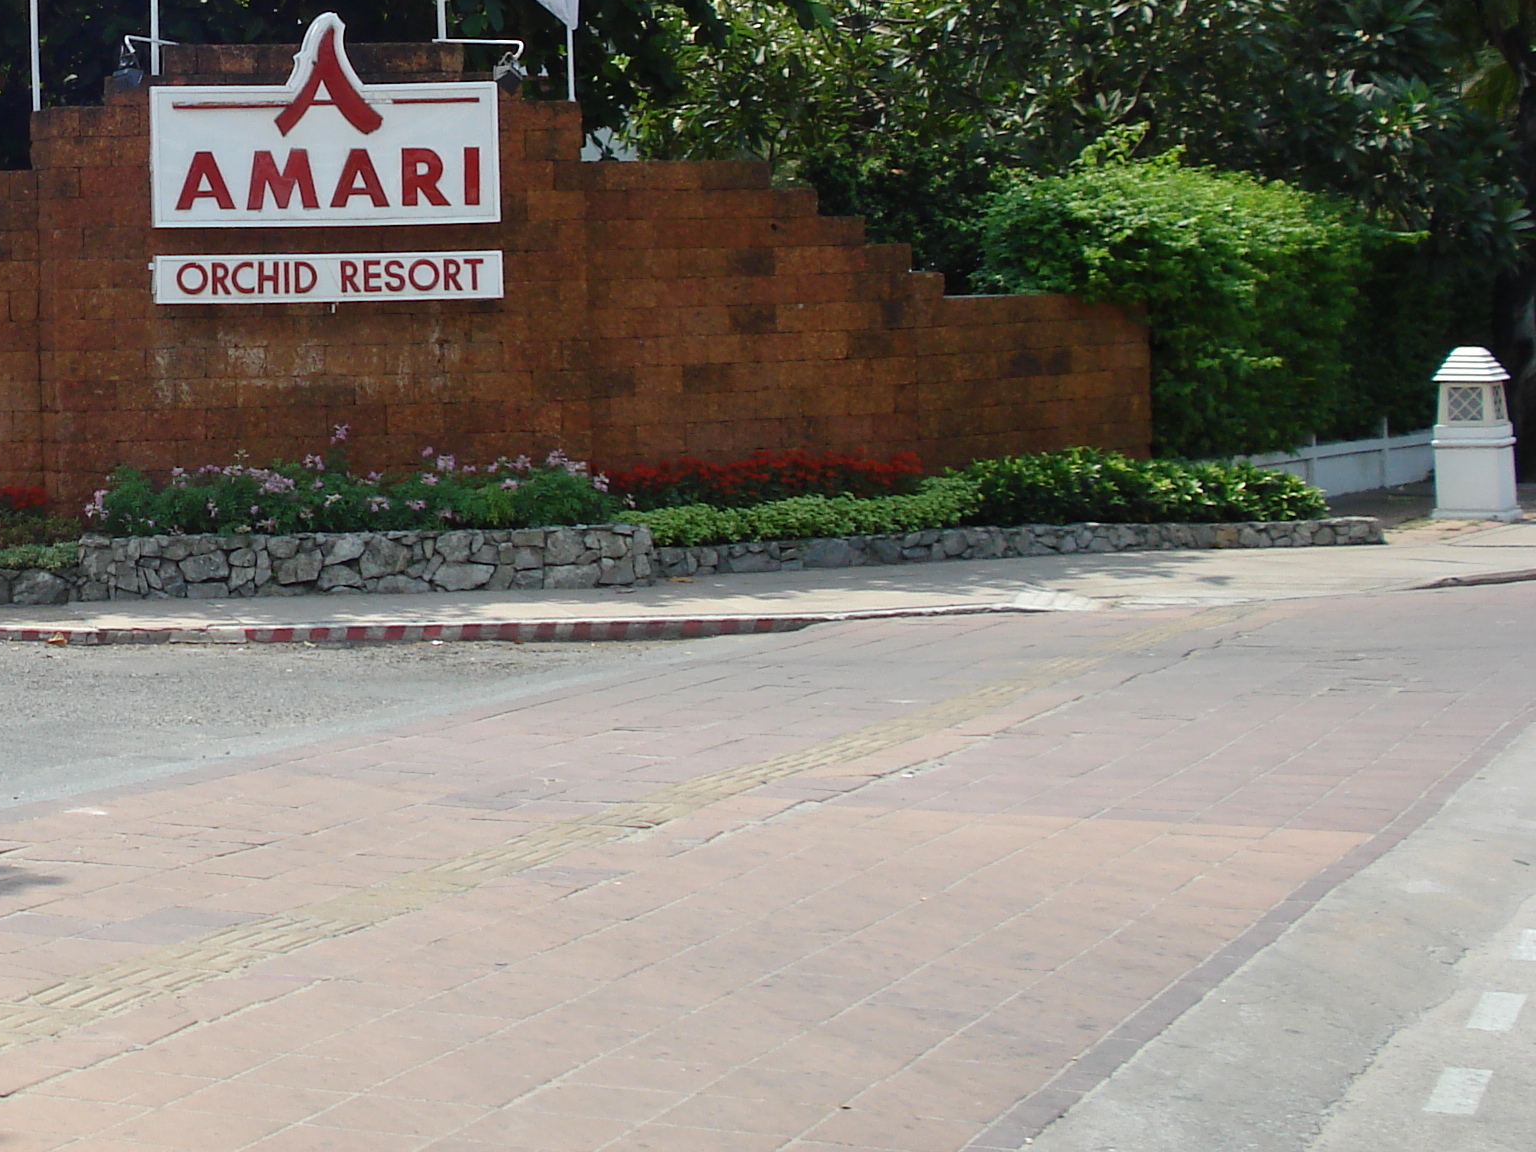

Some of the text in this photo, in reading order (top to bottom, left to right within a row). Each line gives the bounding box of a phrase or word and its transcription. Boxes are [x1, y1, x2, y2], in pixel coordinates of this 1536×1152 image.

[175, 146, 480, 210] AMARI
[176, 258, 484, 295] ORCHID RESORT
